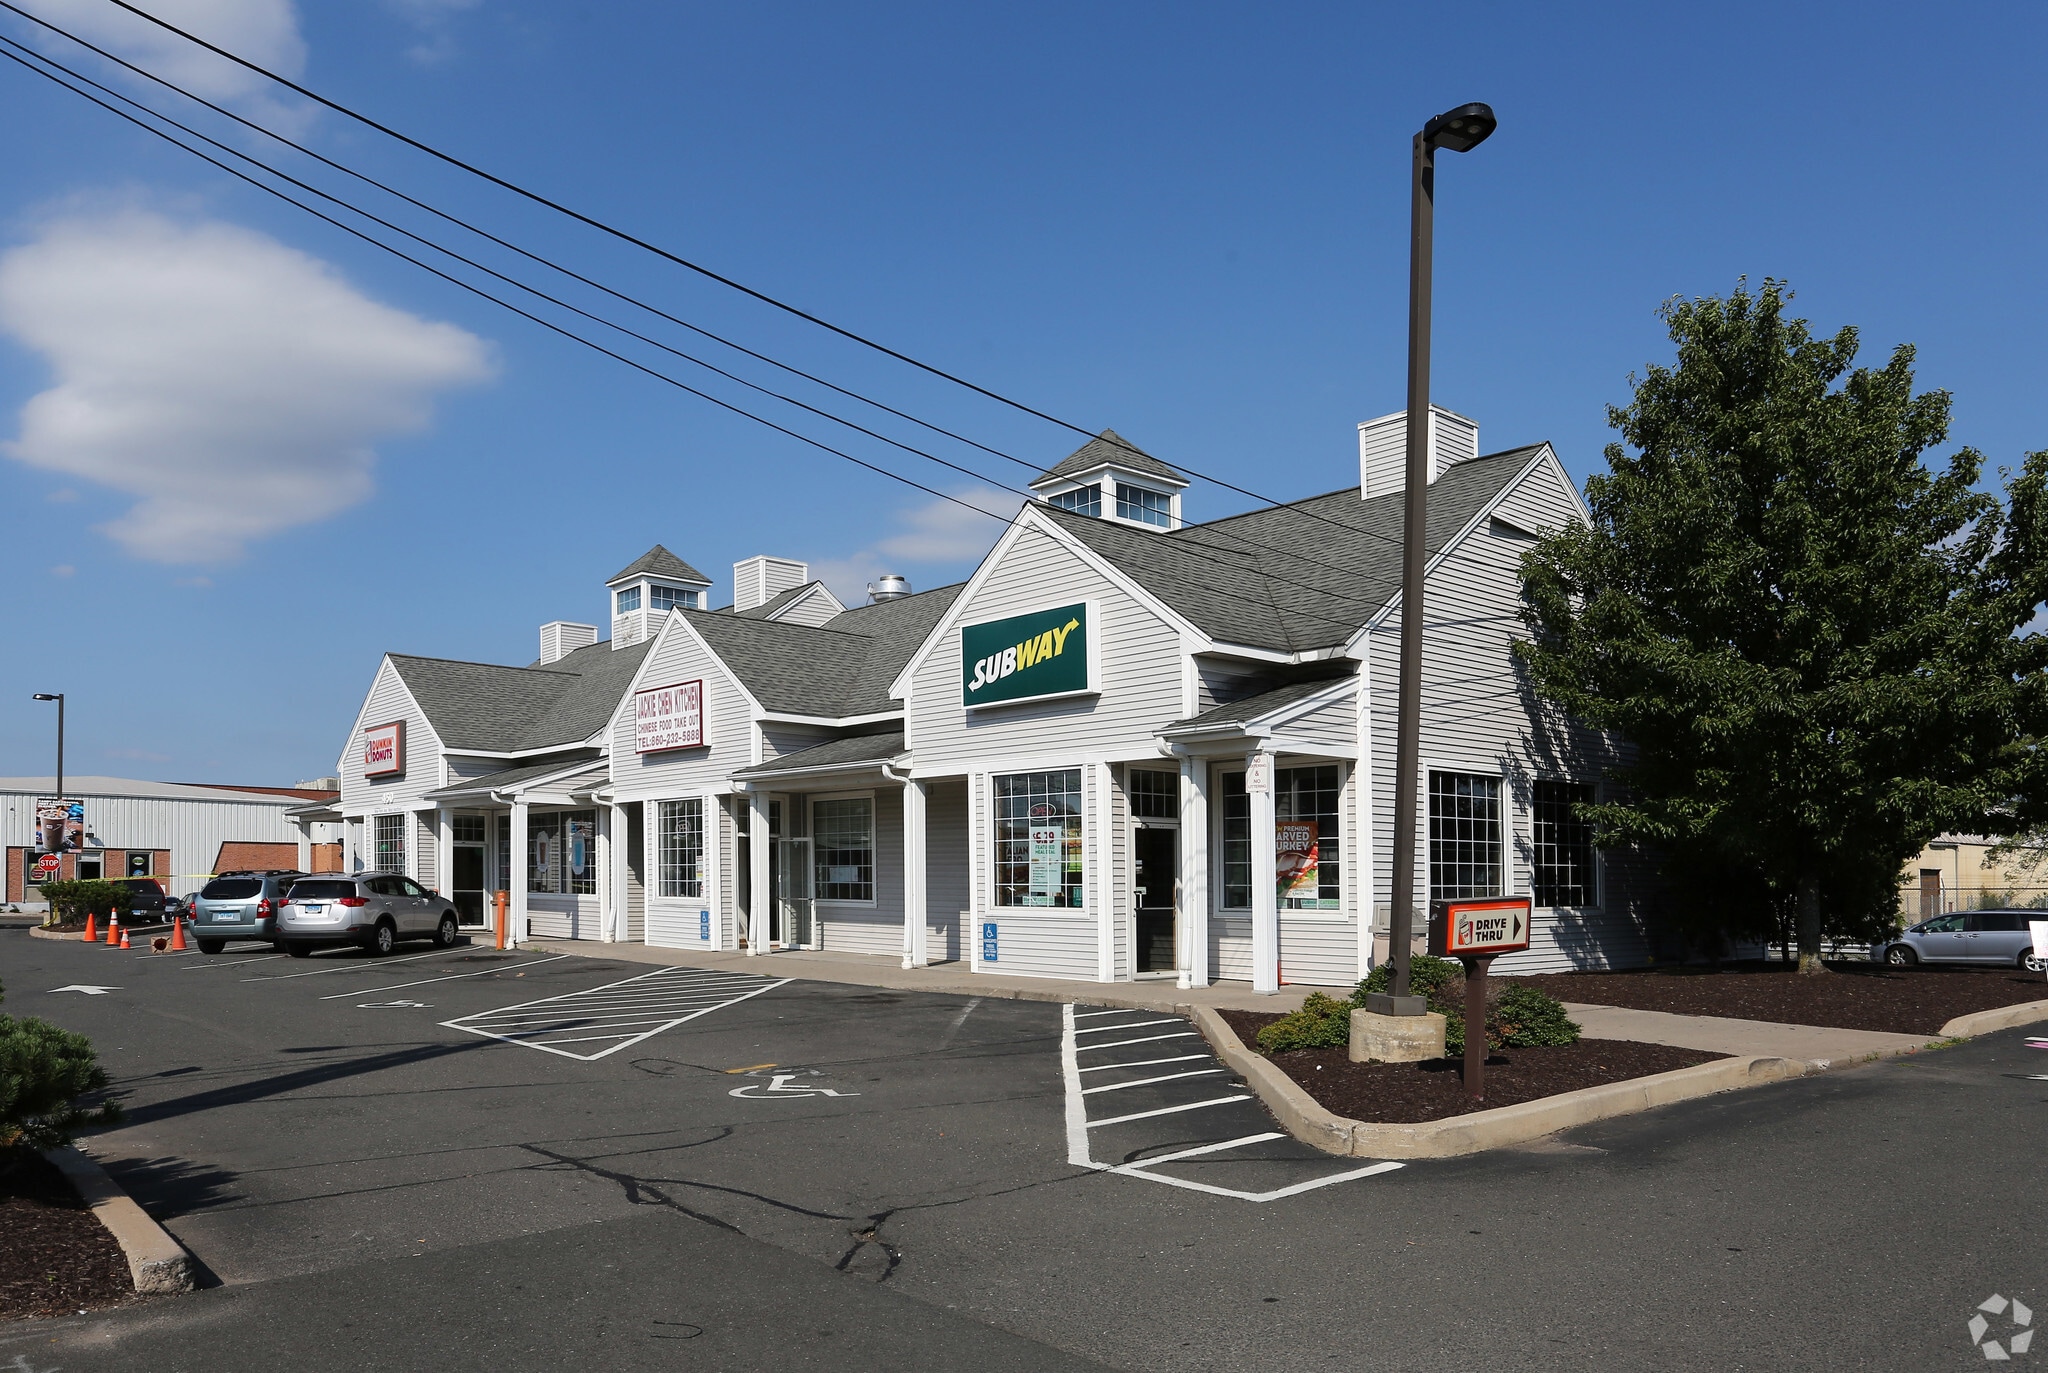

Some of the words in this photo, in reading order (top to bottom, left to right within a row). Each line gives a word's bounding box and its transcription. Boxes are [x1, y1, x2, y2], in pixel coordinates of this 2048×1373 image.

[968, 618, 1080, 692] SUBWAY
[638, 694, 656, 719] JACKIE
[658, 691, 673, 716] CHEN
[675, 686, 699, 713] KITCHEN
[637, 722, 657, 734] CHINESE
[659, 719, 672, 731] FOOD
[674, 716, 687, 729] TAKE
[689, 714, 699, 726] OUT
[372, 748, 393, 762] DONUTS
[1031, 806, 1053, 816] OPEN
[1276, 831, 1310, 841] ARVED
[1276, 841, 1309, 851] URKEY
[40, 859, 59, 867] STOP
[1476, 918, 1507, 931] DRIVE
[1475, 930, 1503, 942] THRU
